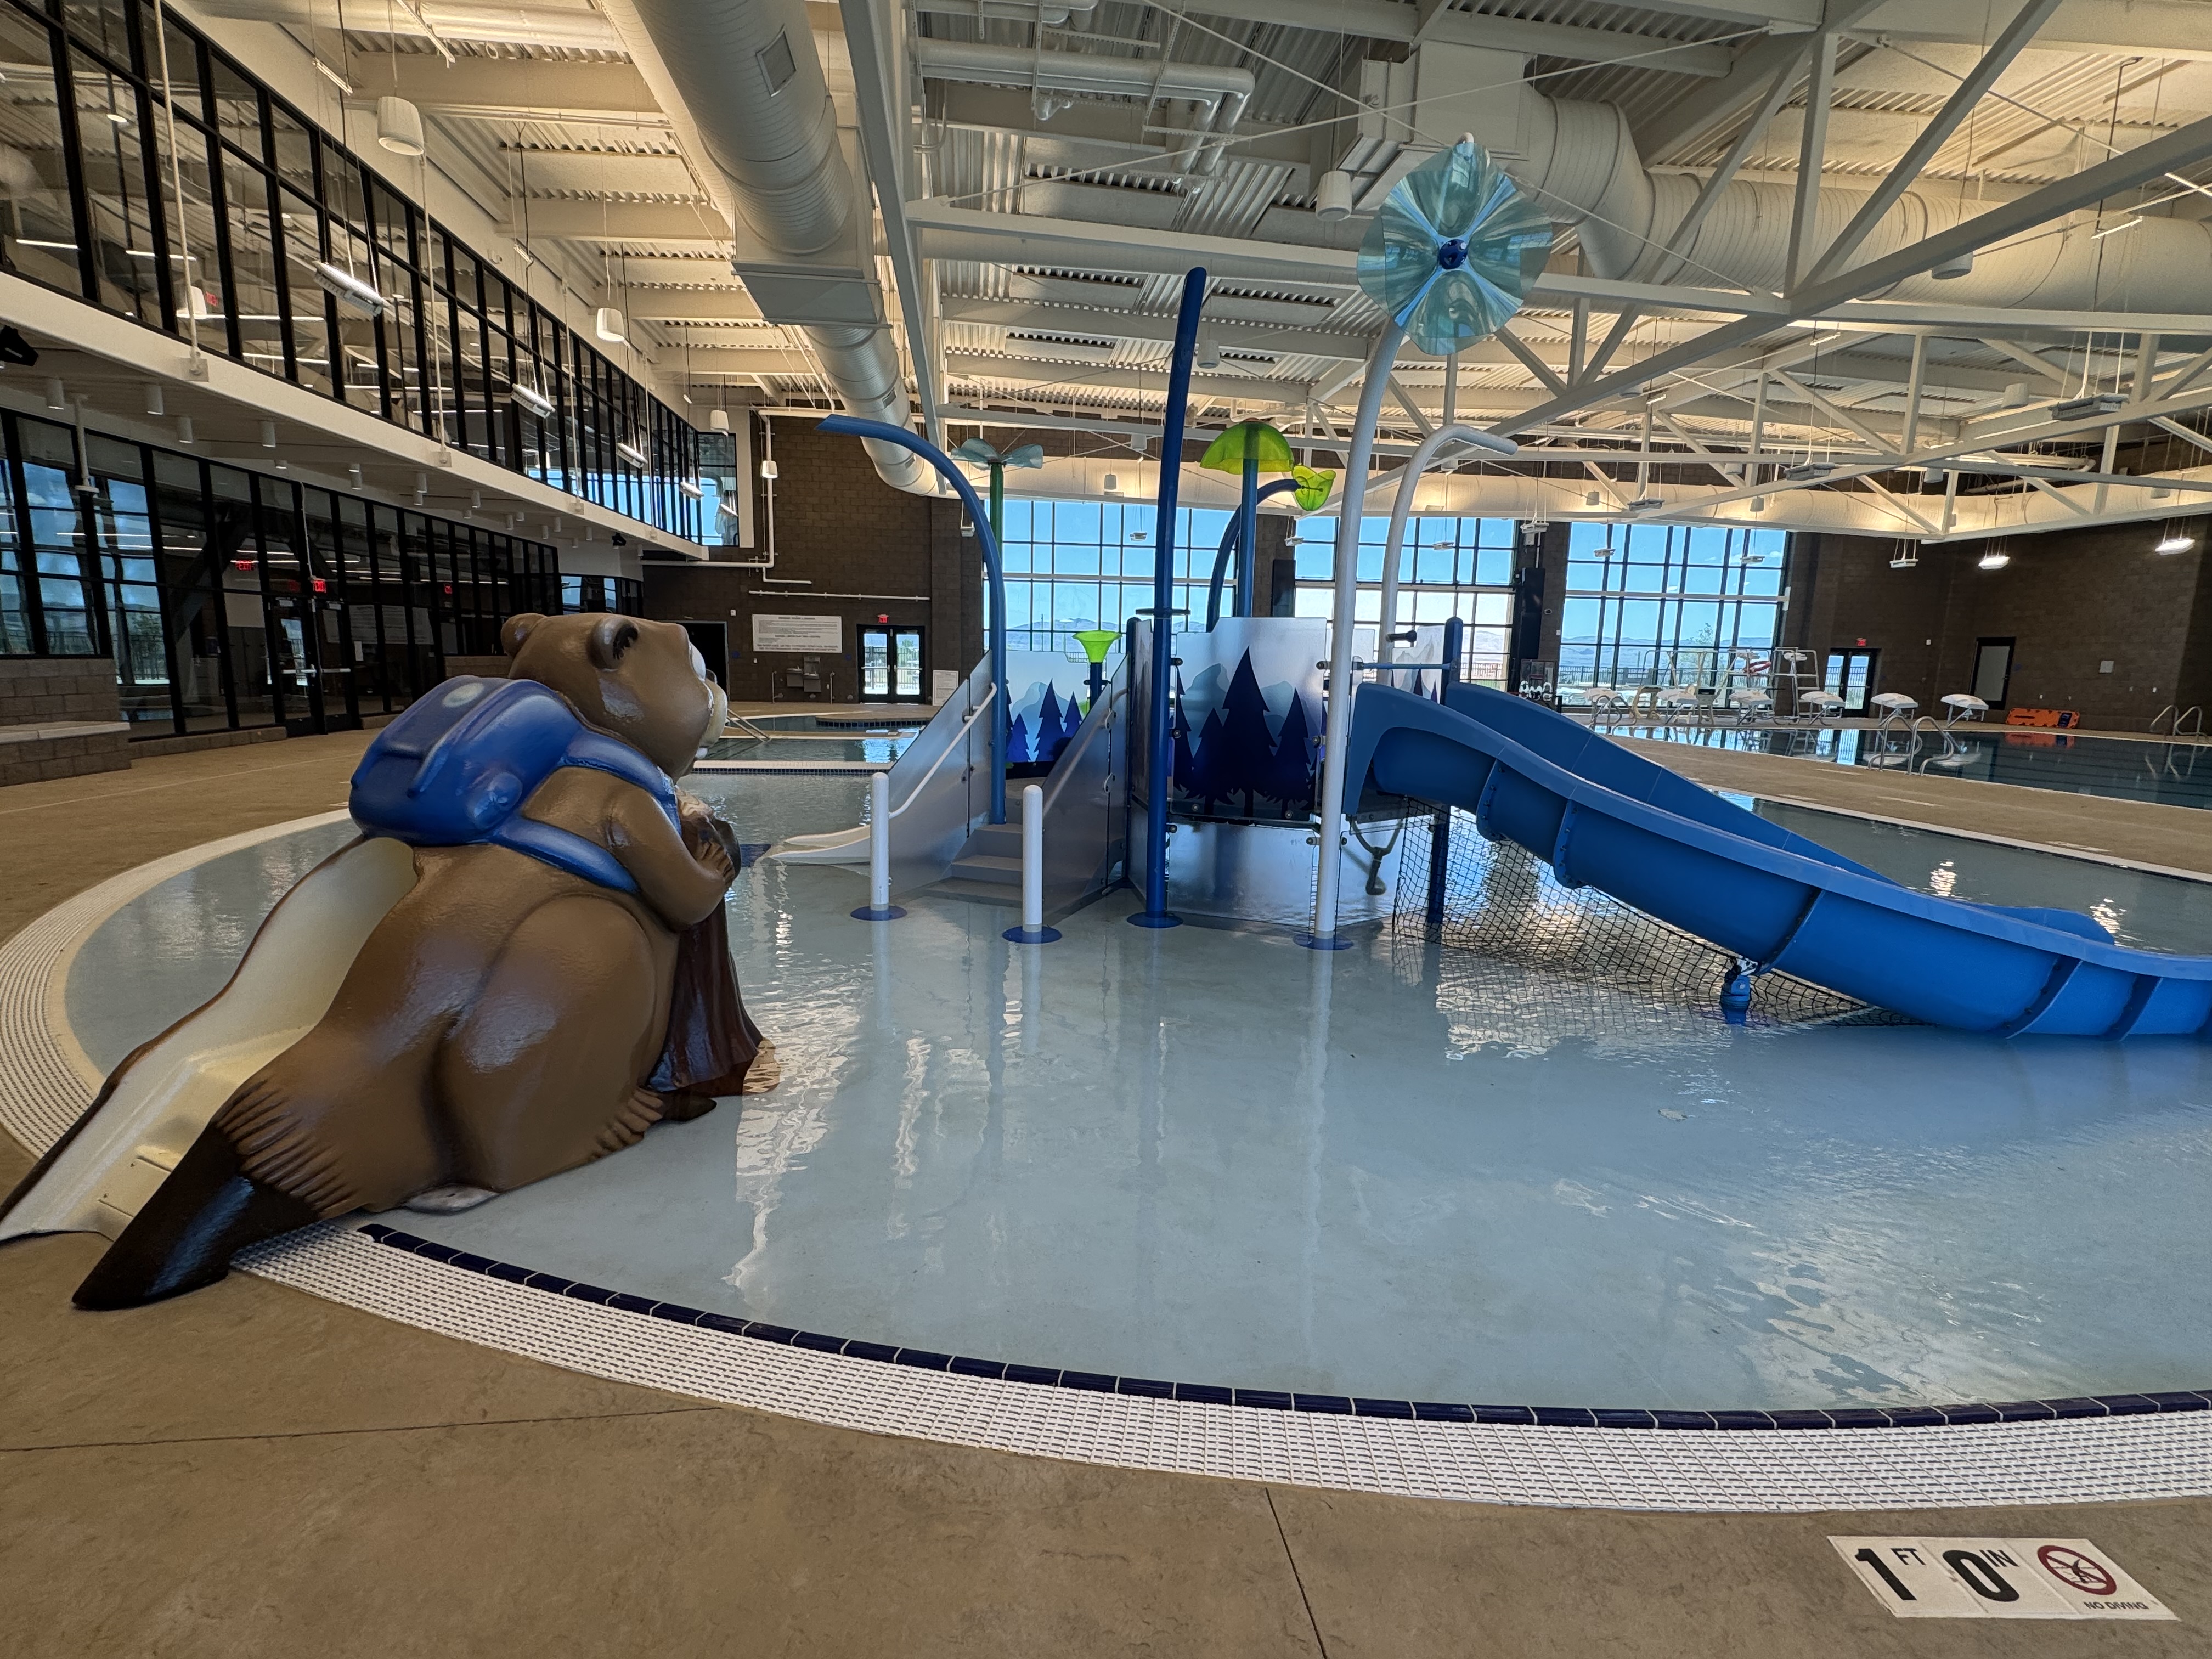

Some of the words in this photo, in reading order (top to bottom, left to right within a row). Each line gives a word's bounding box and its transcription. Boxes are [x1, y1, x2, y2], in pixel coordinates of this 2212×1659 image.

[1891, 1548, 1926, 1565] FT
[1979, 1549, 2019, 1567] IN
[1855, 1548, 1917, 1600] 1
[1942, 1550, 2020, 1602] 0
[2084, 1601, 2105, 1610] NO
[2104, 1601, 2150, 1610] DIVING
